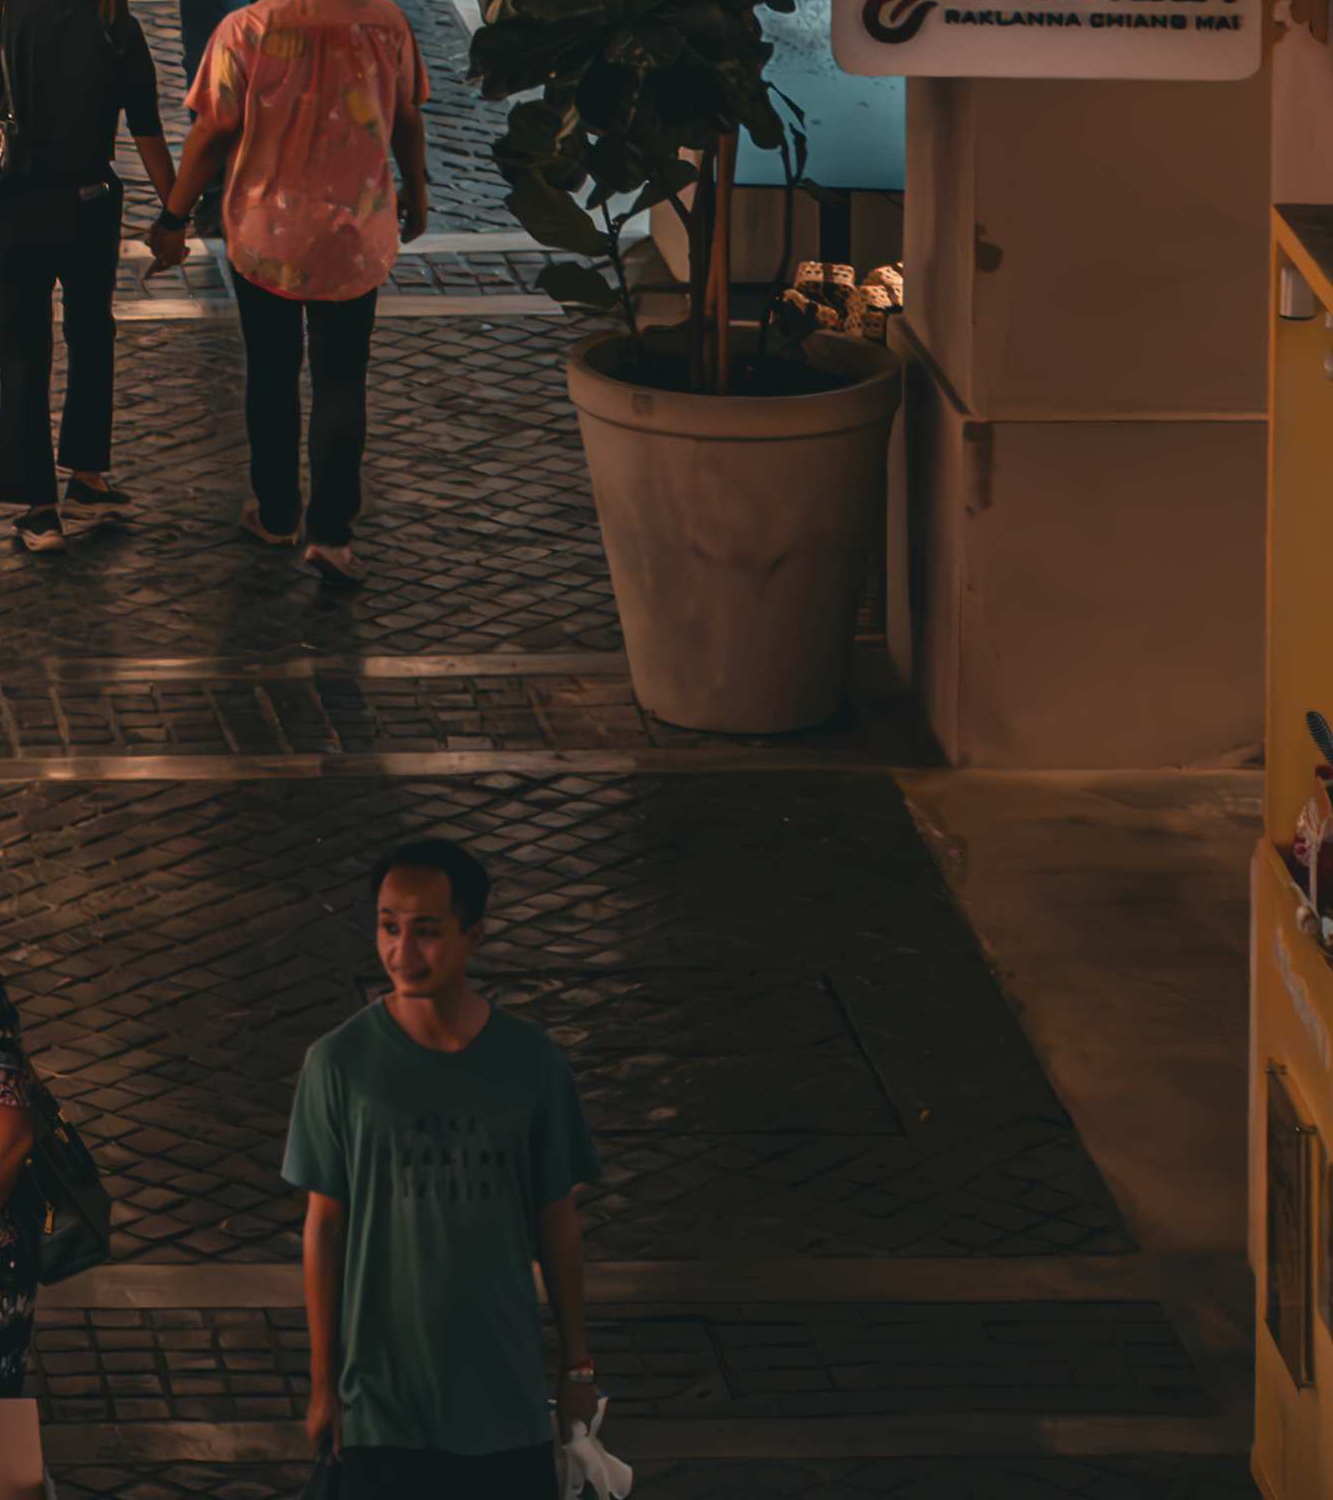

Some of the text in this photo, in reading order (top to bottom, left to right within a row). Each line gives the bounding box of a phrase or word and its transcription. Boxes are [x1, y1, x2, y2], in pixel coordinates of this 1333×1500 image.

[944, 9, 1242, 31] RAKLANNA CHIANG MAI
